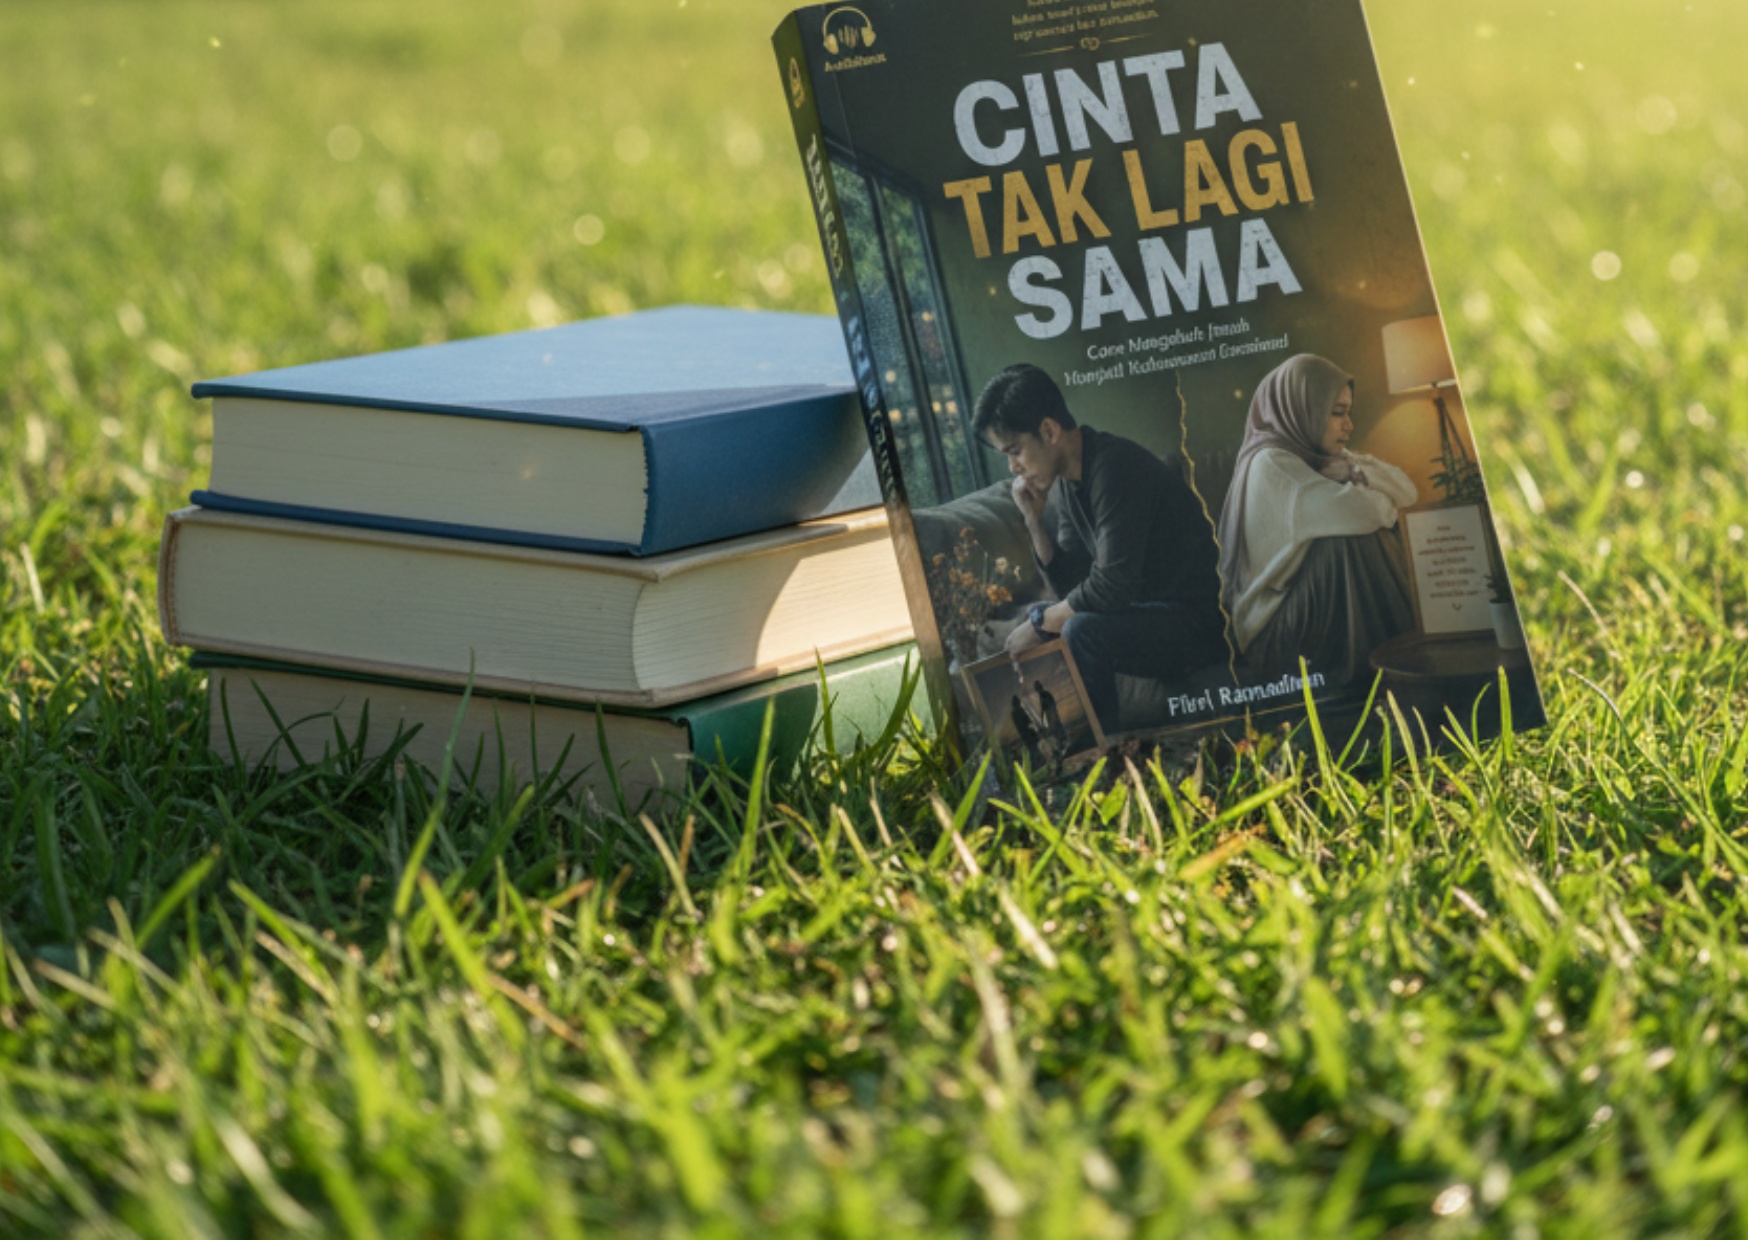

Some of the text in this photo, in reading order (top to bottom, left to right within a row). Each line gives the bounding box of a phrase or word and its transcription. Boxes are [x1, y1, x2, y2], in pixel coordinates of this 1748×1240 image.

[953, 42, 1263, 166] CINTA
[943, 158, 1112, 258] TAK
[1123, 121, 1314, 231] LAGI
[1007, 218, 1302, 340] SAMA
